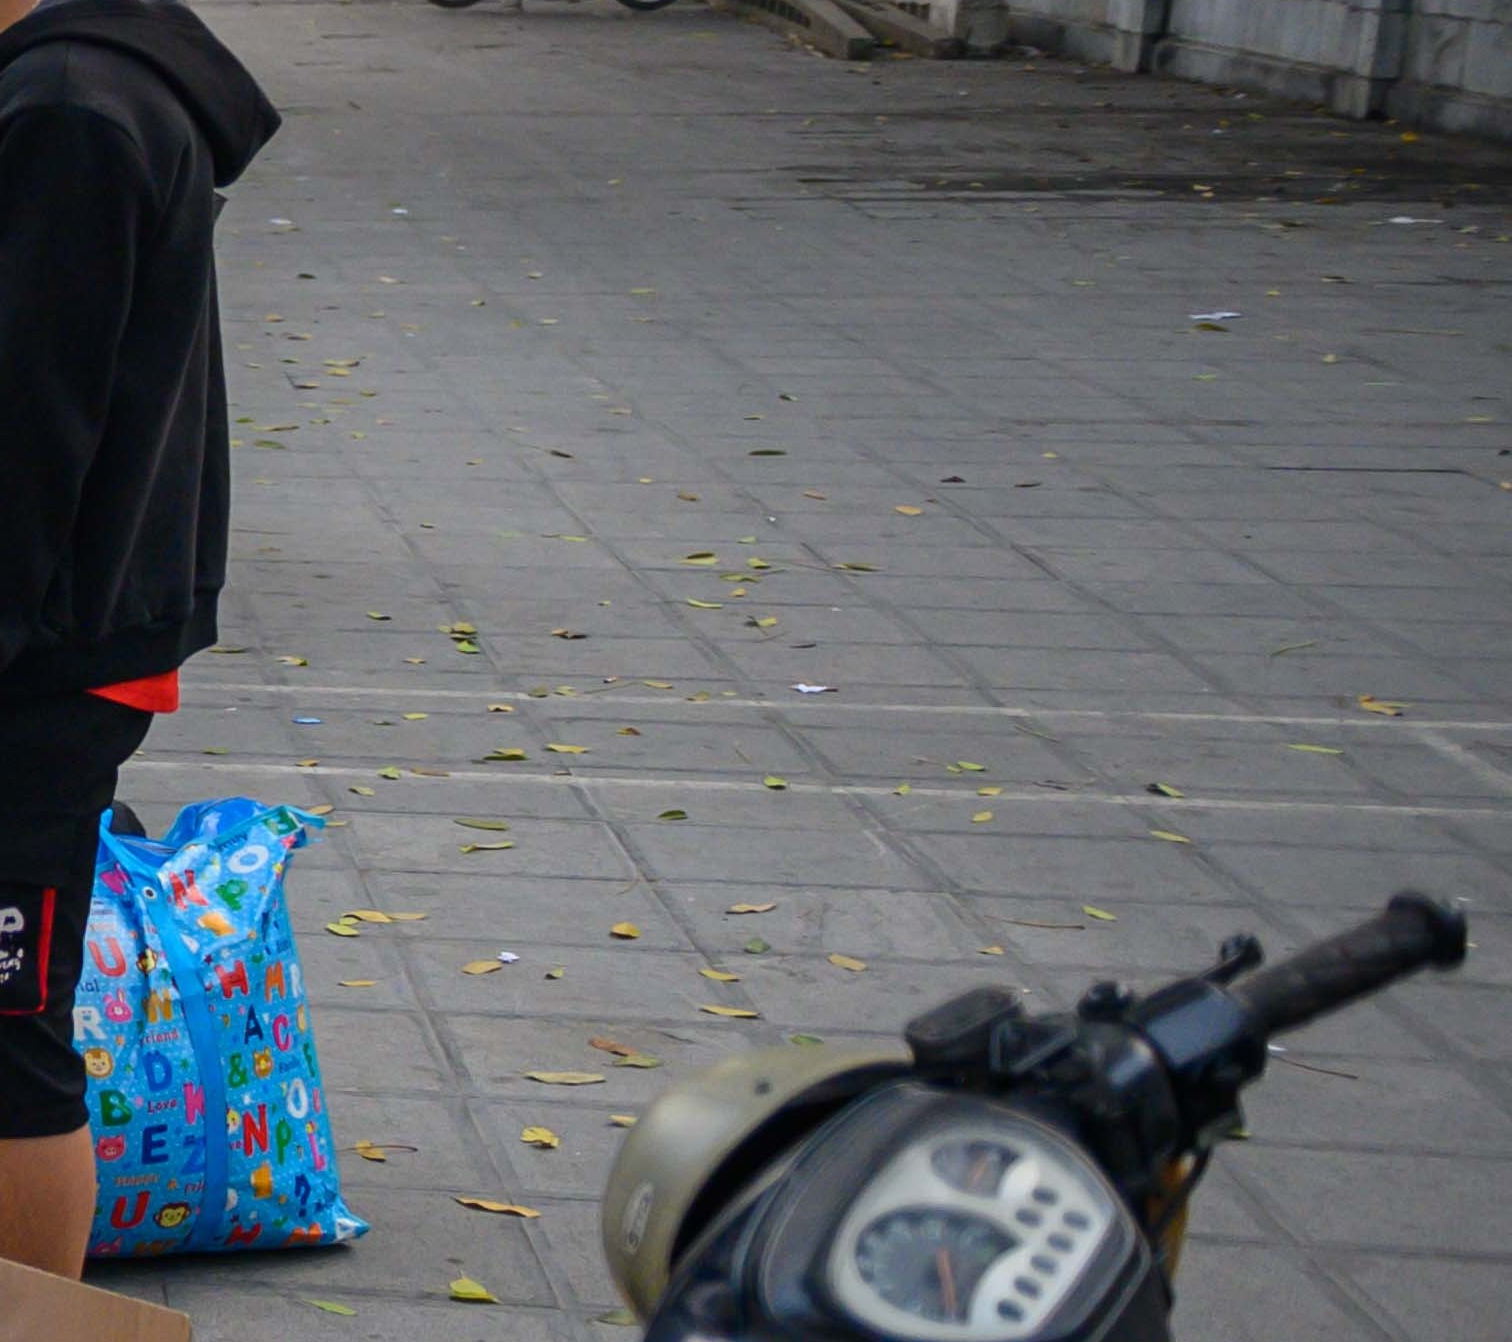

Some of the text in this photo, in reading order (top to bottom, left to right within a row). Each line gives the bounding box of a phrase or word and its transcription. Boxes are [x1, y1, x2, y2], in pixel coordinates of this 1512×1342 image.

[87, 936, 128, 978] U
[72, 1006, 107, 1041] R
[244, 1004, 264, 1045] A
[272, 1013, 292, 1052] C
[142, 1051, 173, 1092] D
[100, 1089, 133, 1127] B
[148, 1097, 178, 1114] Love
[141, 1124, 169, 1165] E
[110, 1190, 151, 1229] U
